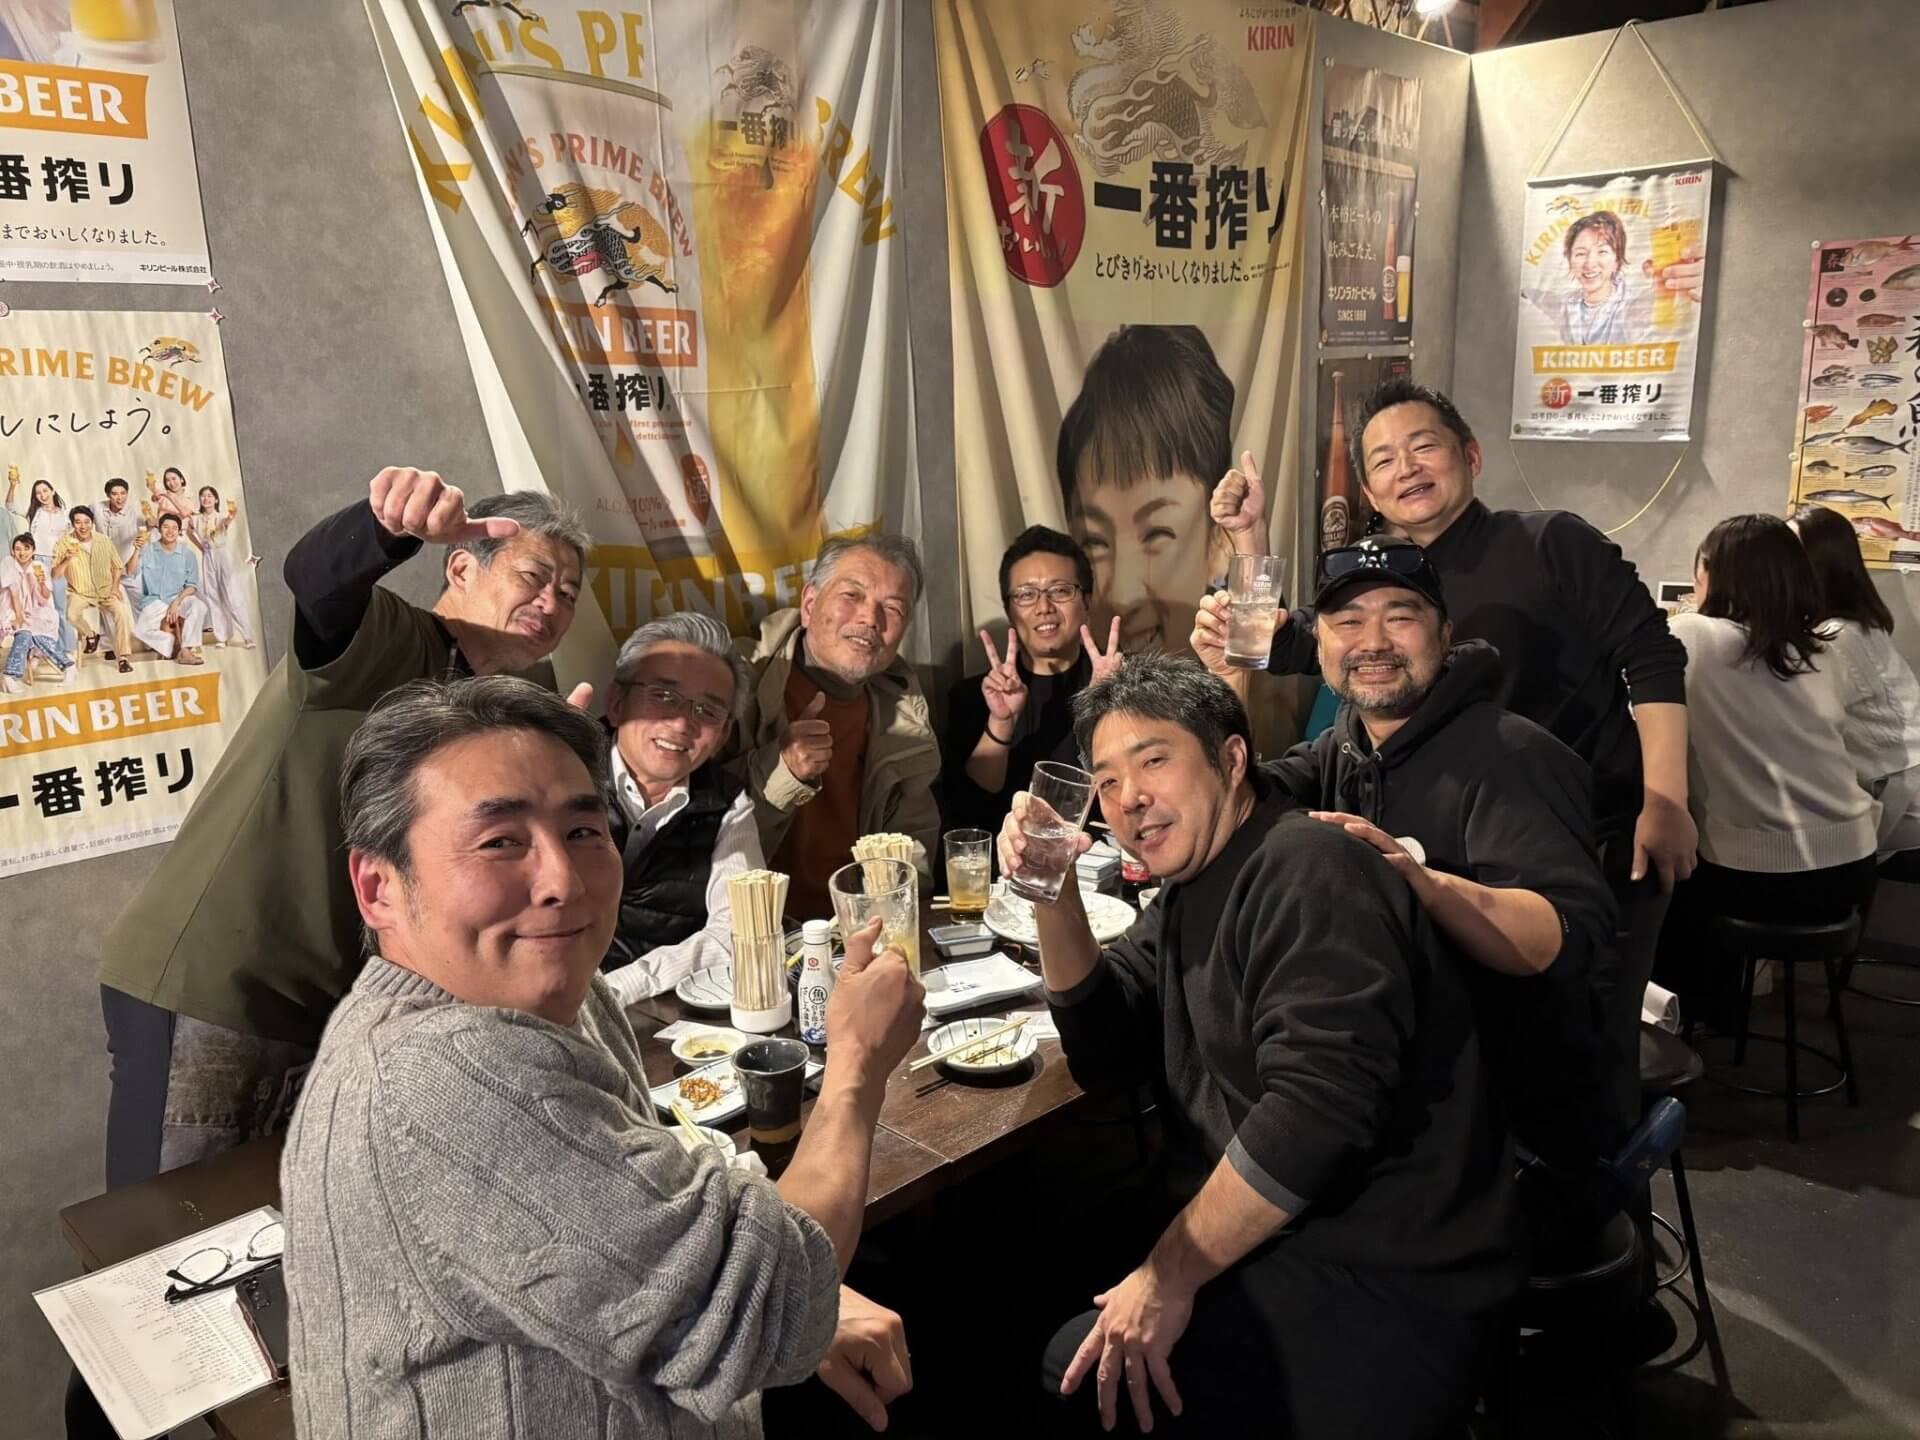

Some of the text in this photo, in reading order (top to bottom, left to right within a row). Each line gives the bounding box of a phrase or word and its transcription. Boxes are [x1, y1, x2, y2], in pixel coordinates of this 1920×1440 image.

[1247, 23, 1297, 51] KIRIN
[0, 73, 130, 125] BEER
[550, 132, 645, 184] PRIME
[1675, 176, 1703, 187] KIRIN
[2, 223, 168, 247] までおいしくなりました。
[139, 263, 207, 274] キリンビール株式会社
[1096, 252, 1249, 285] とびきりおいしくなりました。
[622, 318, 692, 355] BEER
[1541, 348, 1666, 369] KIRIN BEER
[107, 356, 215, 413] BREW
[1545, 384, 1569, 405] 新
[89, 687, 204, 732] BEER
